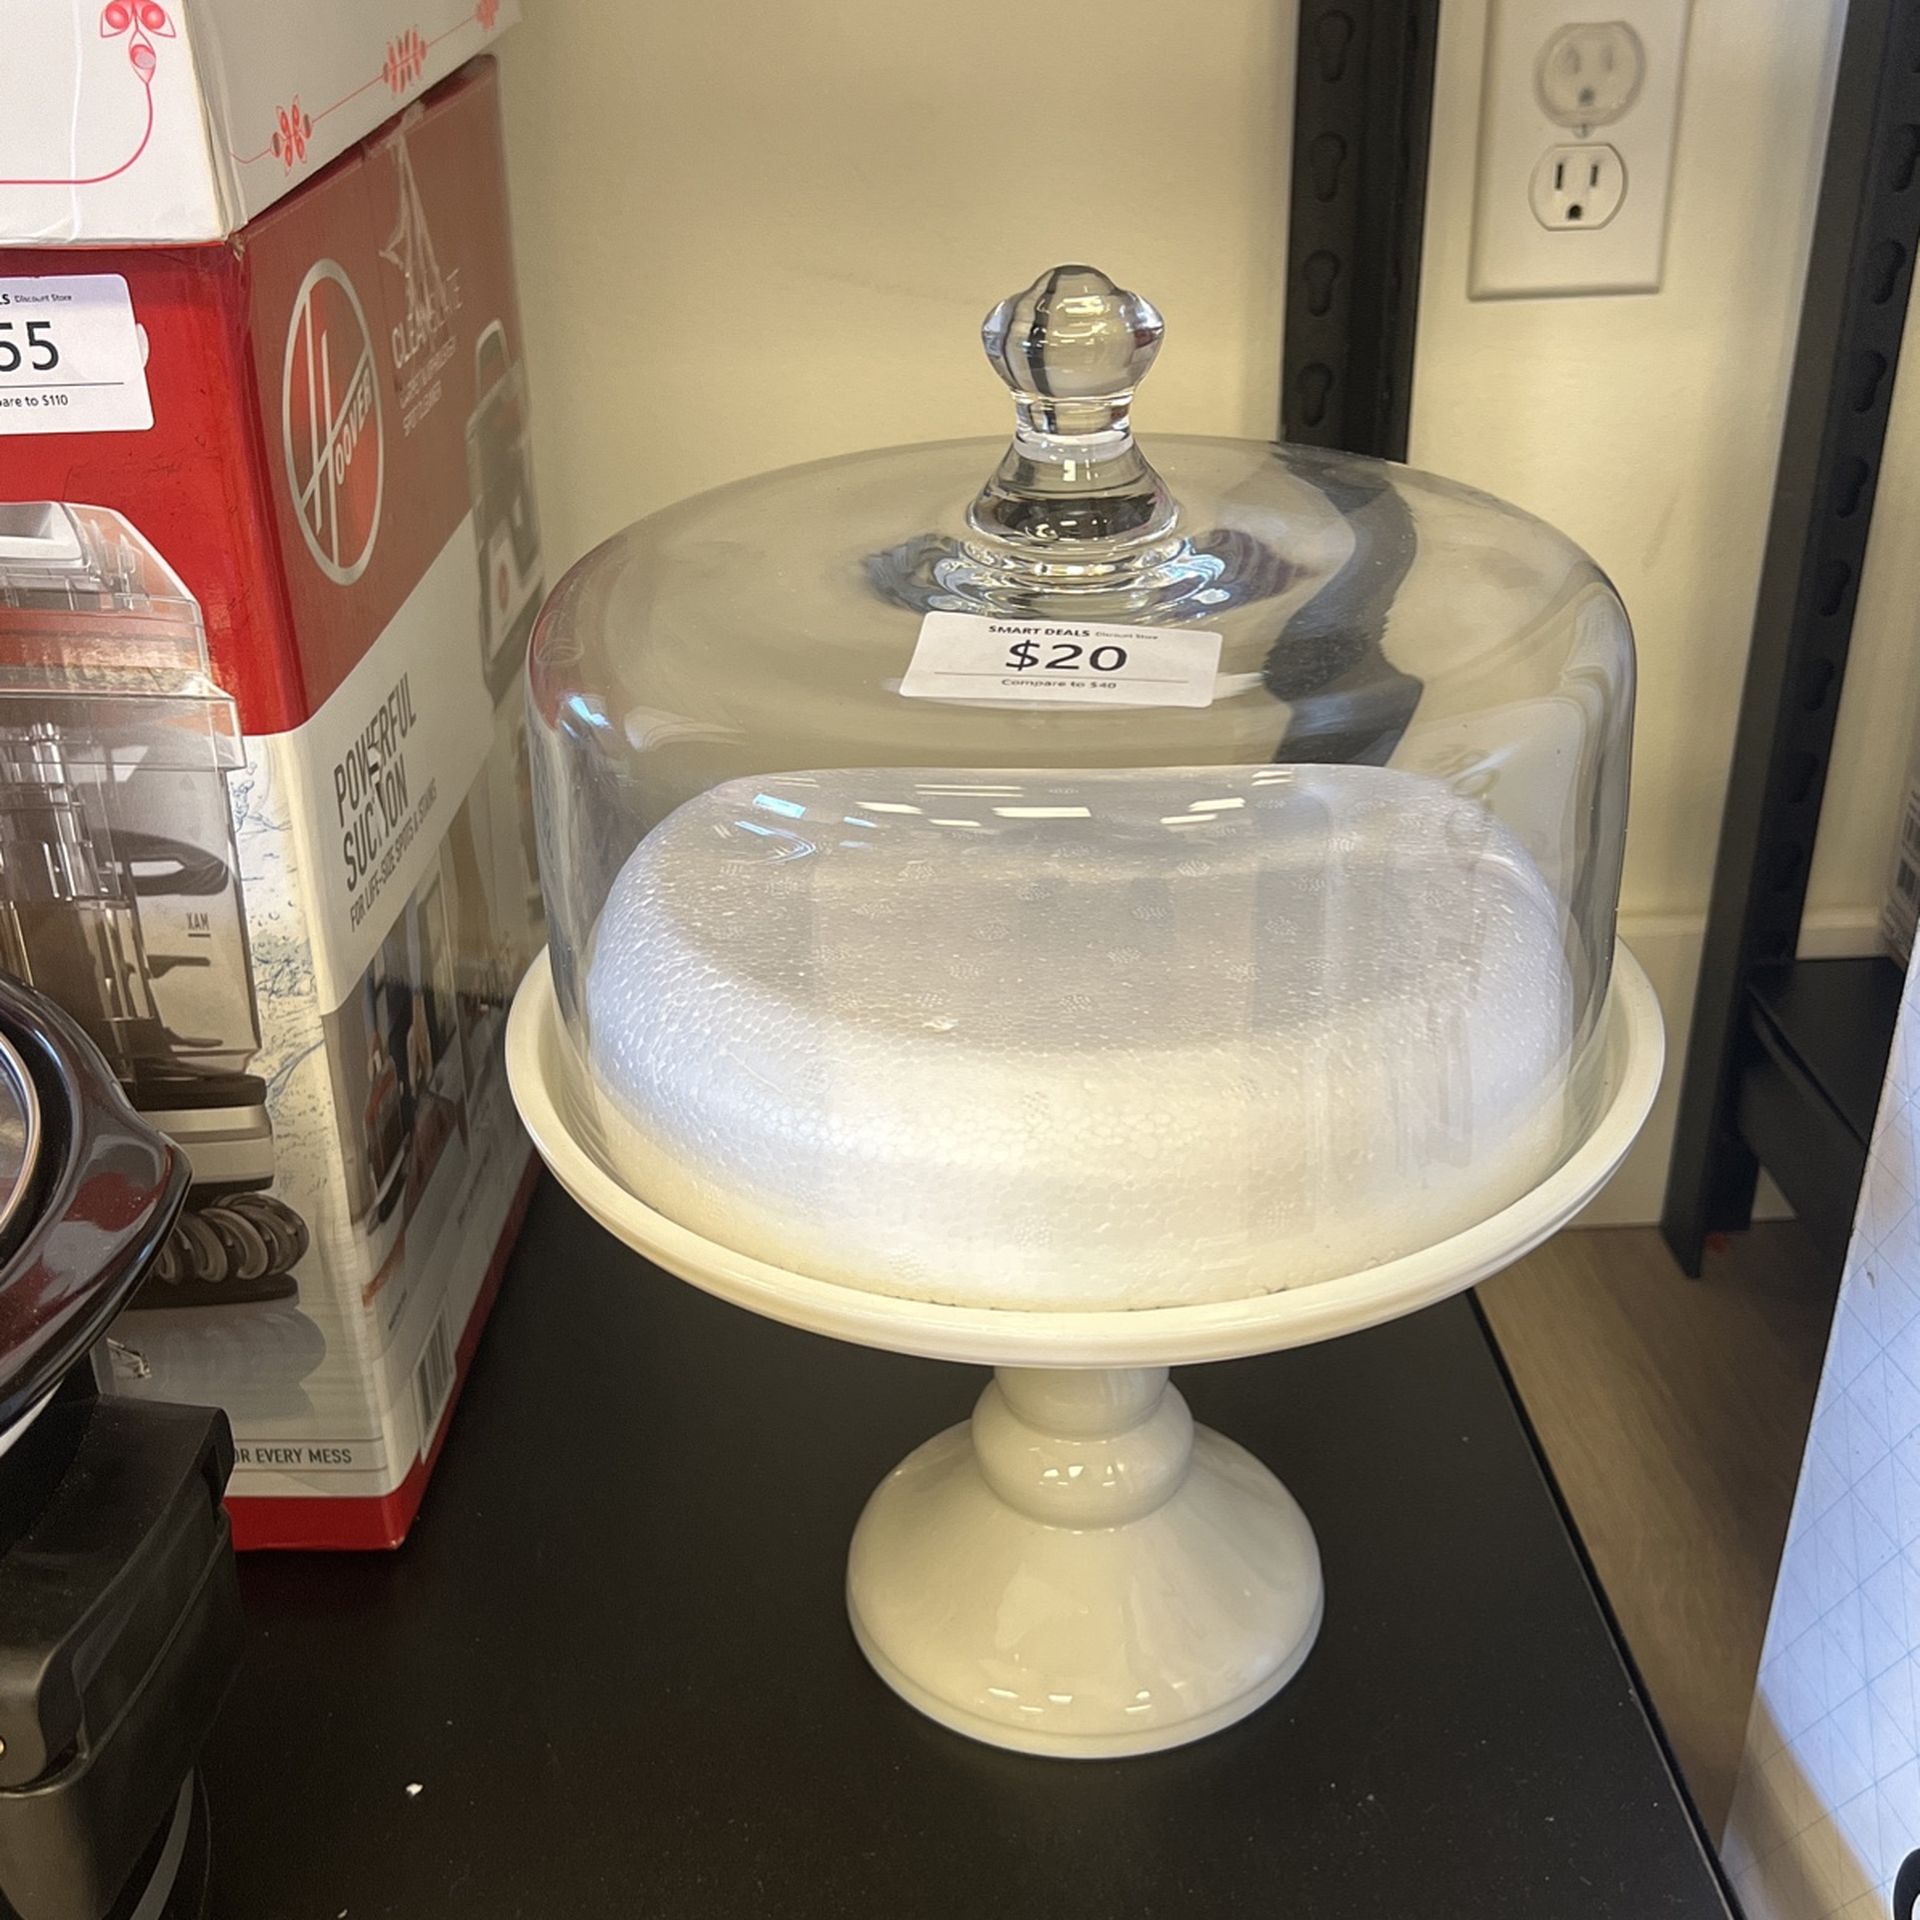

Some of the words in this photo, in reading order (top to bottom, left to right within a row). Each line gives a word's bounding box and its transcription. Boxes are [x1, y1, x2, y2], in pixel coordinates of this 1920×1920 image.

[50, 293, 72, 302] Store
[0, 397, 22, 408] are
[25, 396, 39, 407] to
[988, 625, 1042, 636] SMART
[1044, 627, 1091, 638] DEALS
[1135, 633, 1159, 641] Store
[1005, 639, 1128, 672] $20
[1001, 678, 1067, 689] Compare
[1070, 680, 1086, 688] to
[1090, 682, 1117, 690] $40
[255, 1447, 303, 1463] EVERY
[308, 1447, 352, 1464] MESS
